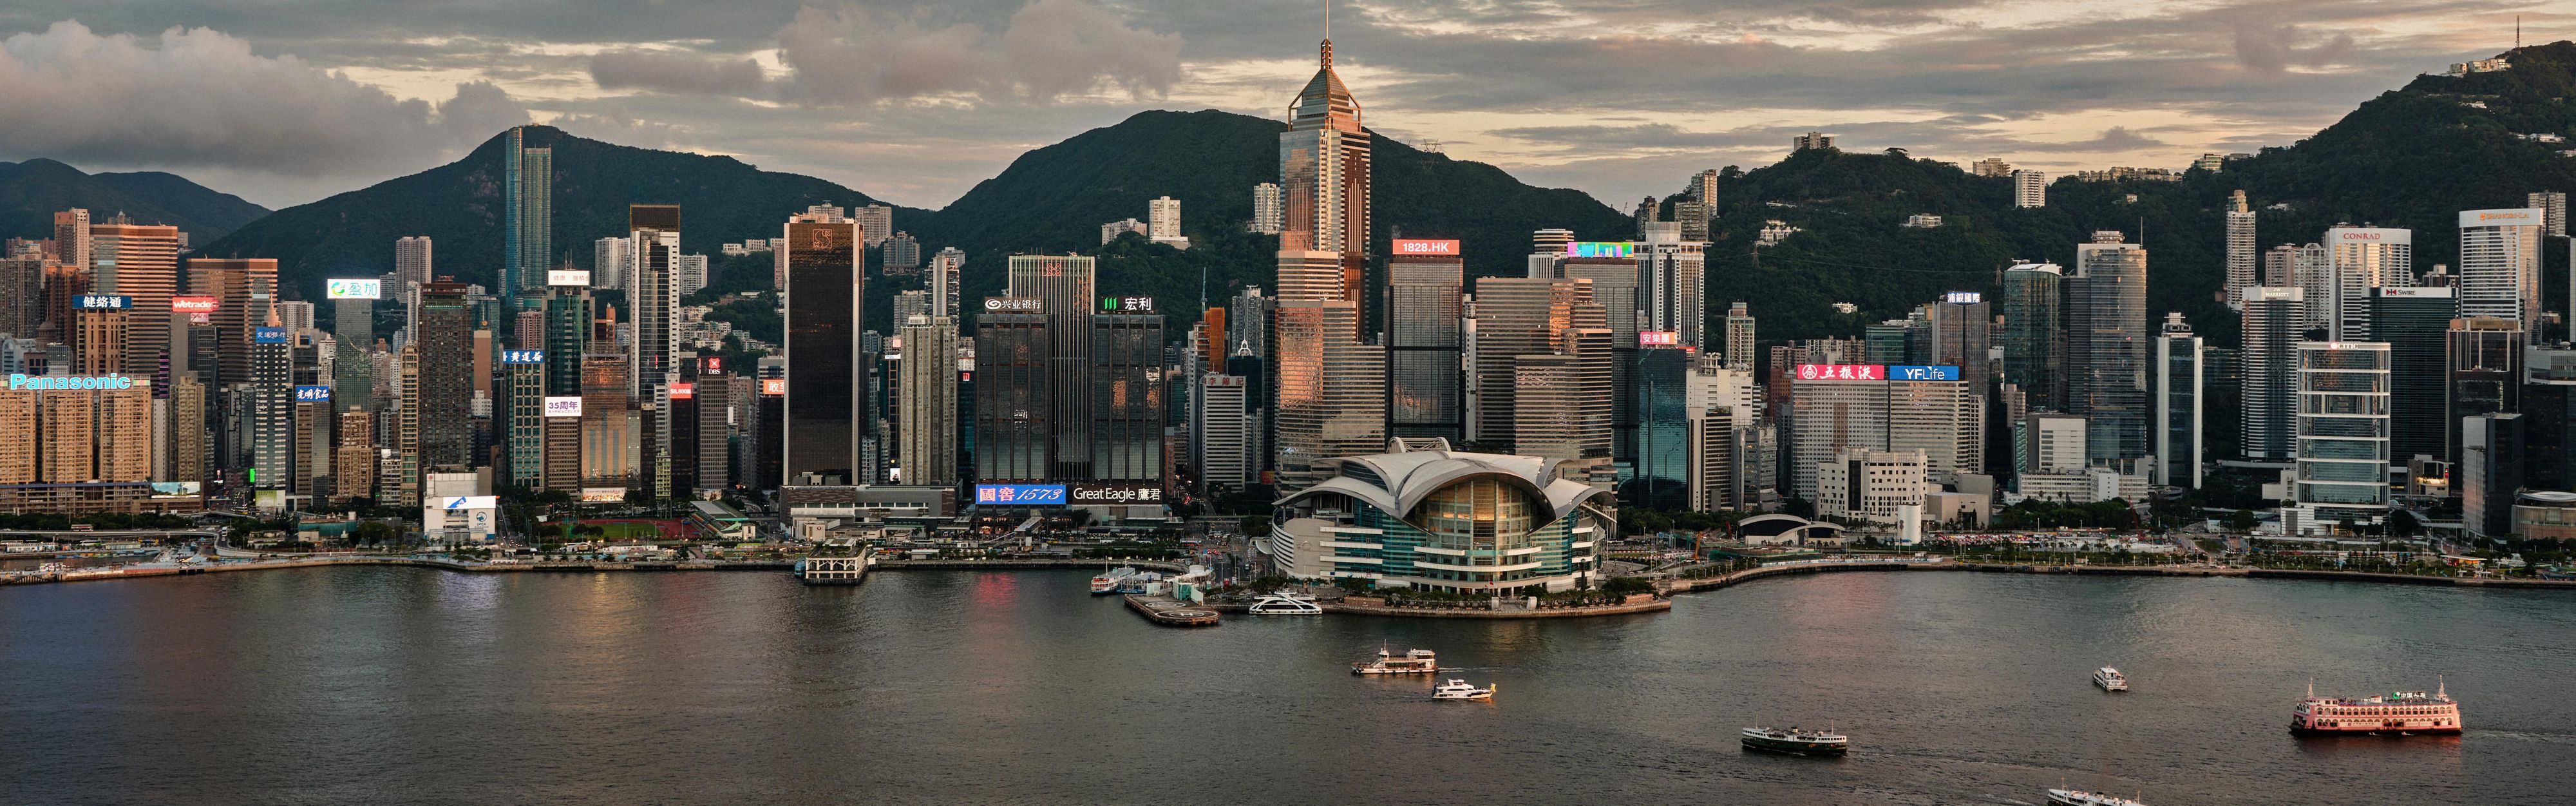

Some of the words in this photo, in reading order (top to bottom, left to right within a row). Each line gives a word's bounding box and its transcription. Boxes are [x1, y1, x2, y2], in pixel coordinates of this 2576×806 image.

[1403, 242, 1449, 252] 1828.HK
[1947, 293, 1980, 303] 浦銀國際
[1001, 300, 1041, 309] 兴业银行
[1124, 297, 1151, 311] 宏利
[1640, 334, 1670, 343] 安集團
[10, 372, 131, 390] Panasonic
[297, 388, 329, 399] 光明食品
[1074, 487, 1104, 499] Great
[1105, 487, 1135, 503] Eagle
[1137, 488, 1162, 501] 鷹君
